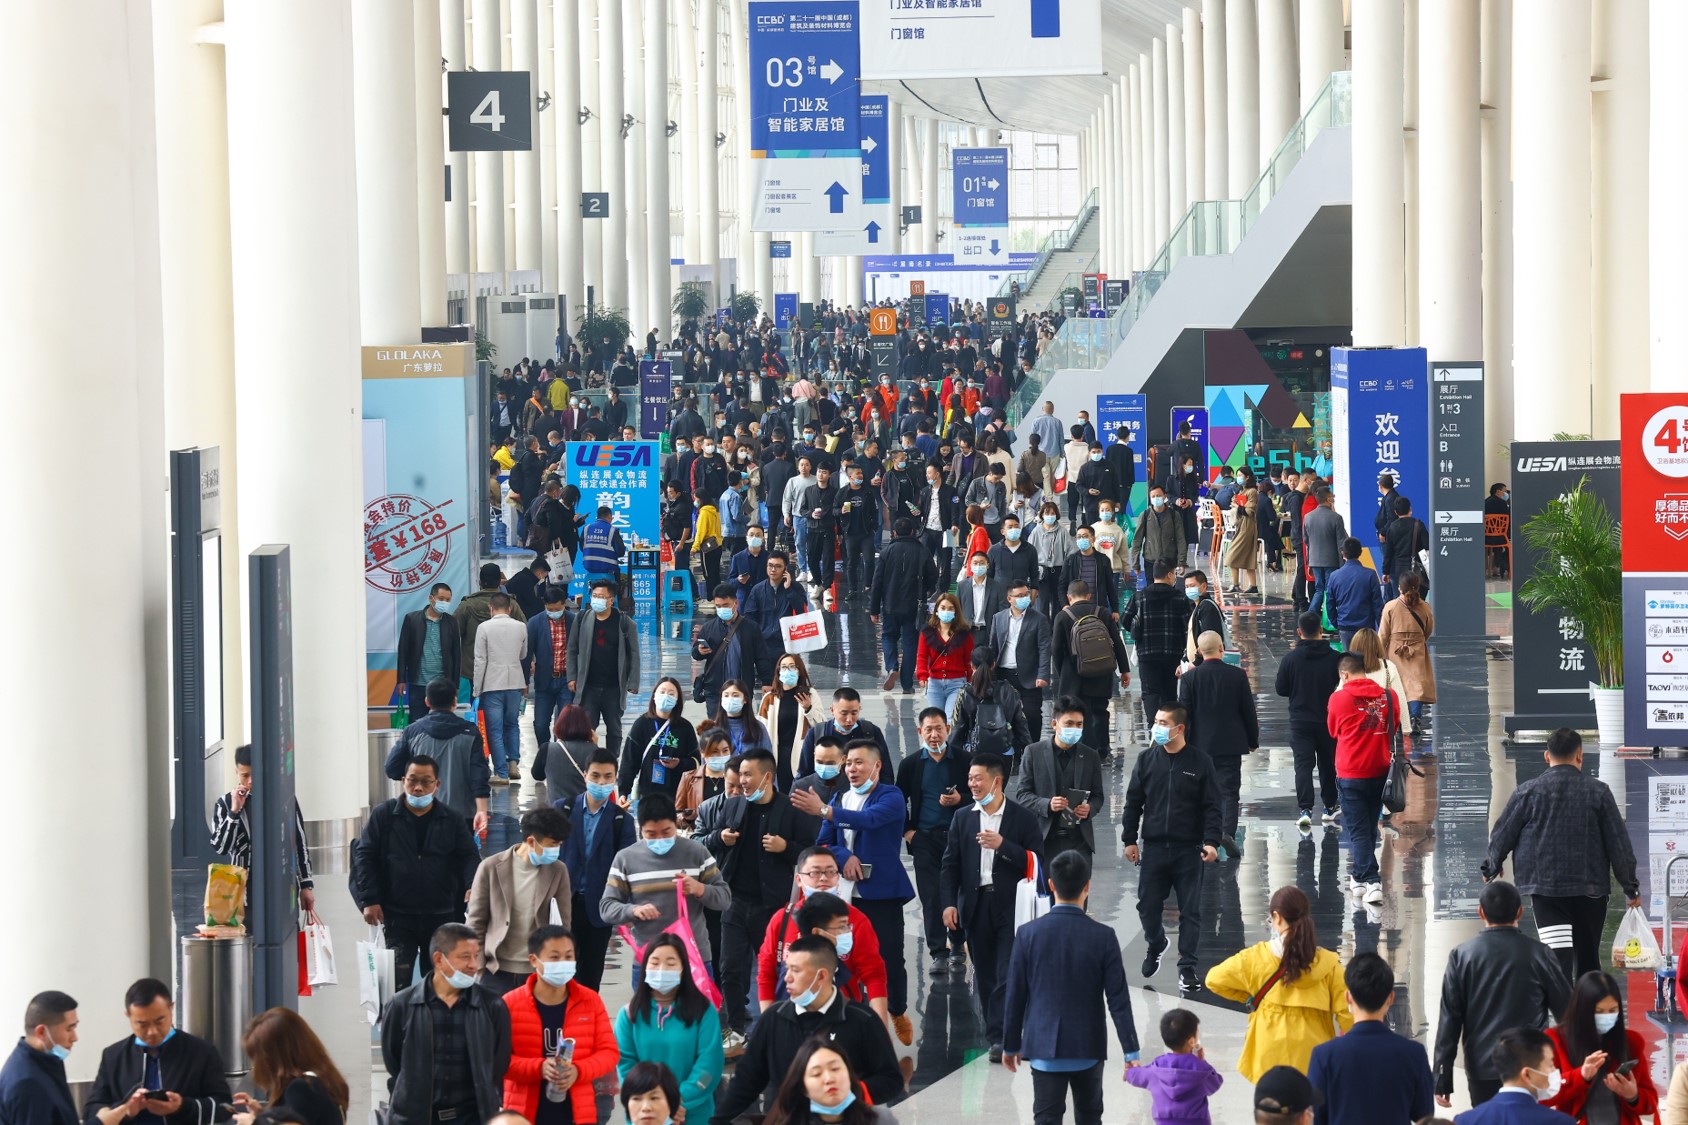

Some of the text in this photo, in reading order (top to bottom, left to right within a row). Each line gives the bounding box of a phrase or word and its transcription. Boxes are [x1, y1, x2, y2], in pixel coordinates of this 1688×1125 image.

[890, 27, 925, 40] 门窗馆
[807, 56, 817, 75] 号馆
[766, 57, 803, 87] 03
[783, 97, 829, 113] 门业及
[469, 91, 506, 131] 4
[767, 117, 845, 133] 智能家居馆
[963, 177, 980, 193] 01
[589, 198, 601, 213] 2
[967, 198, 994, 208] 门窗馆
[909, 210, 914, 220] 1
[963, 245, 982, 255] 出口
[377, 350, 442, 361] GLOLAKA
[403, 362, 443, 373] 广东萝拉
[1440, 385, 1458, 394] 展厅
[1439, 404, 1446, 414] 1
[1453, 404, 1461, 414] 3
[1440, 423, 1458, 432] 入口
[1108, 433, 1137, 442] 办室
[1654, 419, 1682, 454] 4
[1440, 442, 1448, 452] B
[576, 445, 650, 467] UESA
[1517, 457, 1567, 472] UESA
[579, 480, 647, 489] 指定快递合作商
[1441, 527, 1459, 536] 展厅
[1440, 546, 1449, 557] 4
